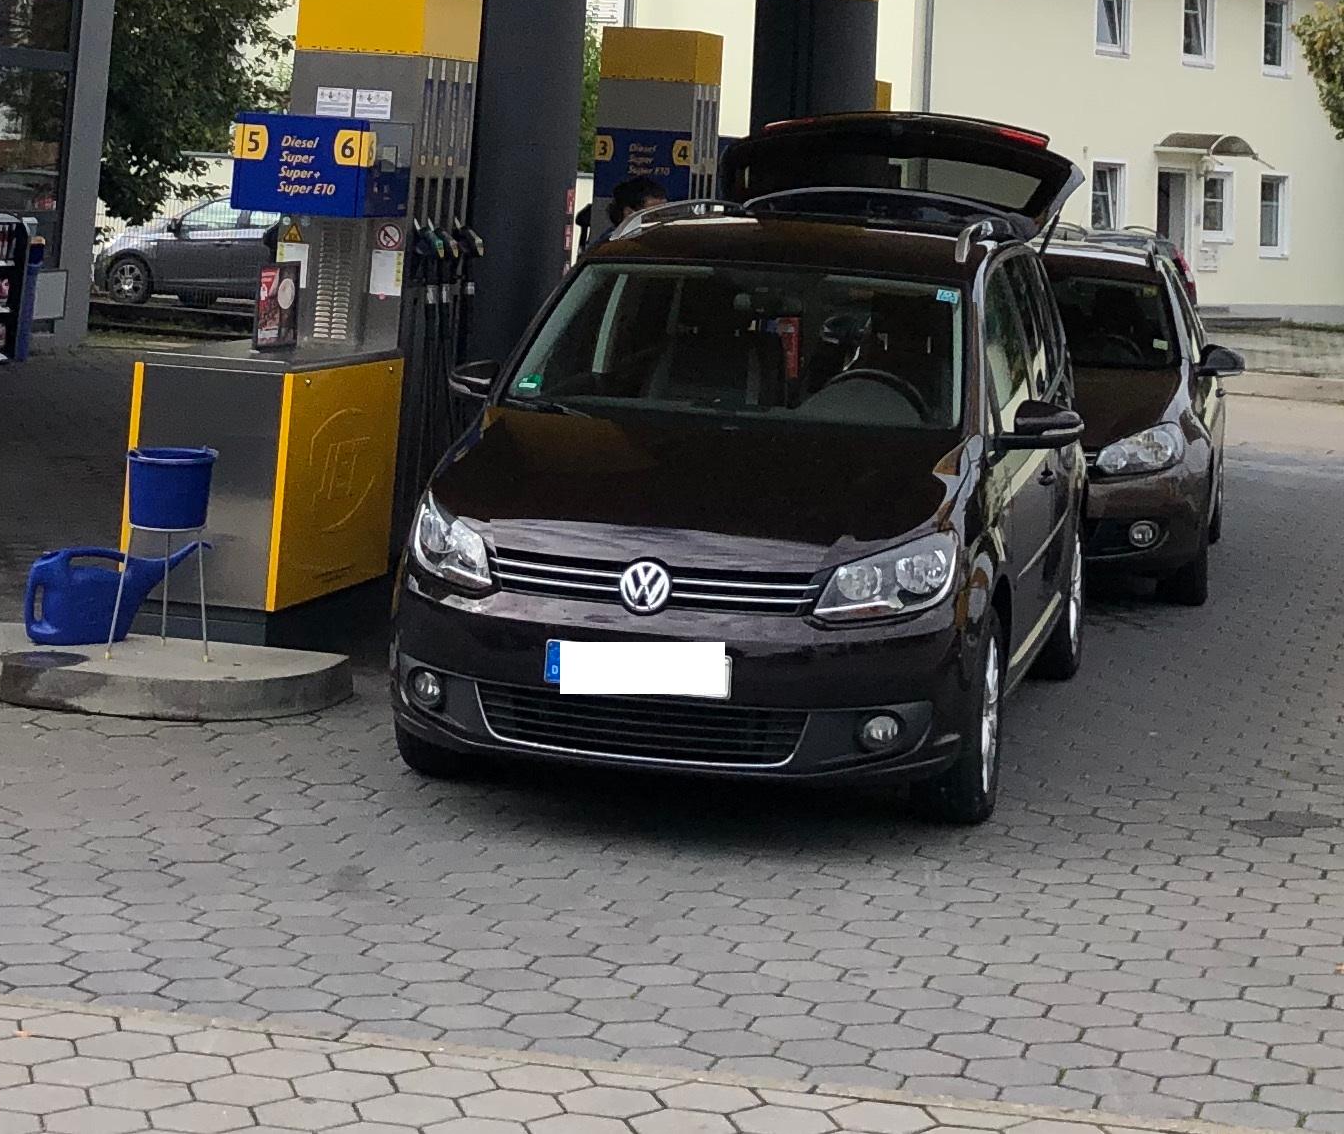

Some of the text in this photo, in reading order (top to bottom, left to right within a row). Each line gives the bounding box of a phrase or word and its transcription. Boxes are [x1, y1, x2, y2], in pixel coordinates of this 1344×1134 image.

[247, 131, 260, 152] 5
[281, 135, 320, 149] Diesel
[341, 137, 355, 159] 6
[598, 140, 608, 156] 3
[279, 151, 316, 166] Super
[677, 145, 689, 161] 4
[278, 166, 321, 181] Super+
[277, 181, 336, 196] Super E10
